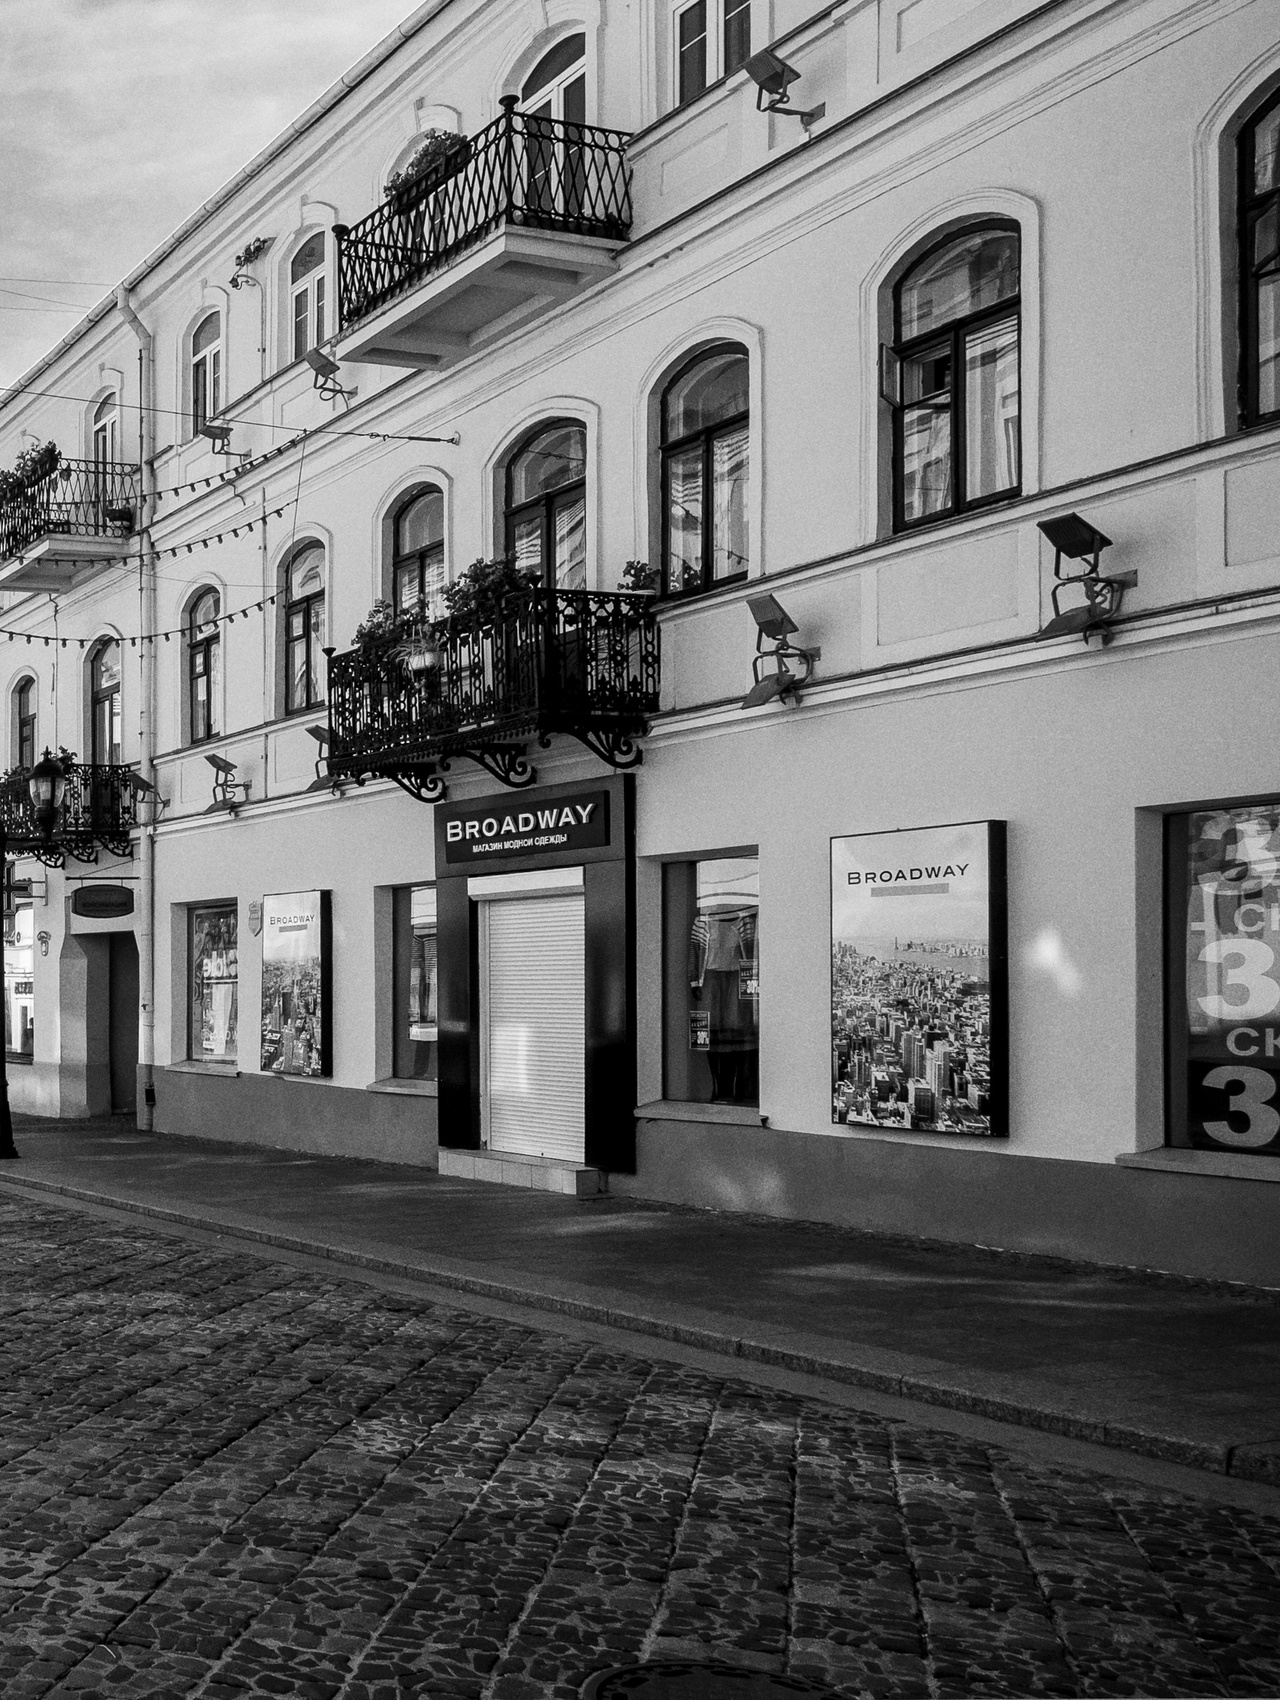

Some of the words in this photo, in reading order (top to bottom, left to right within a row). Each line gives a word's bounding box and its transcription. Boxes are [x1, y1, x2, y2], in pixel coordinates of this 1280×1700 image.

[446, 803, 596, 842] BROADWAY
[472, 842, 503, 853] МАГАЗИН
[534, 833, 568, 846] ОДЕЖДЫ
[847, 863, 970, 885] BROADWAY
[269, 914, 316, 926] BROADWAY
[696, 1031, 710, 1044] 30%
